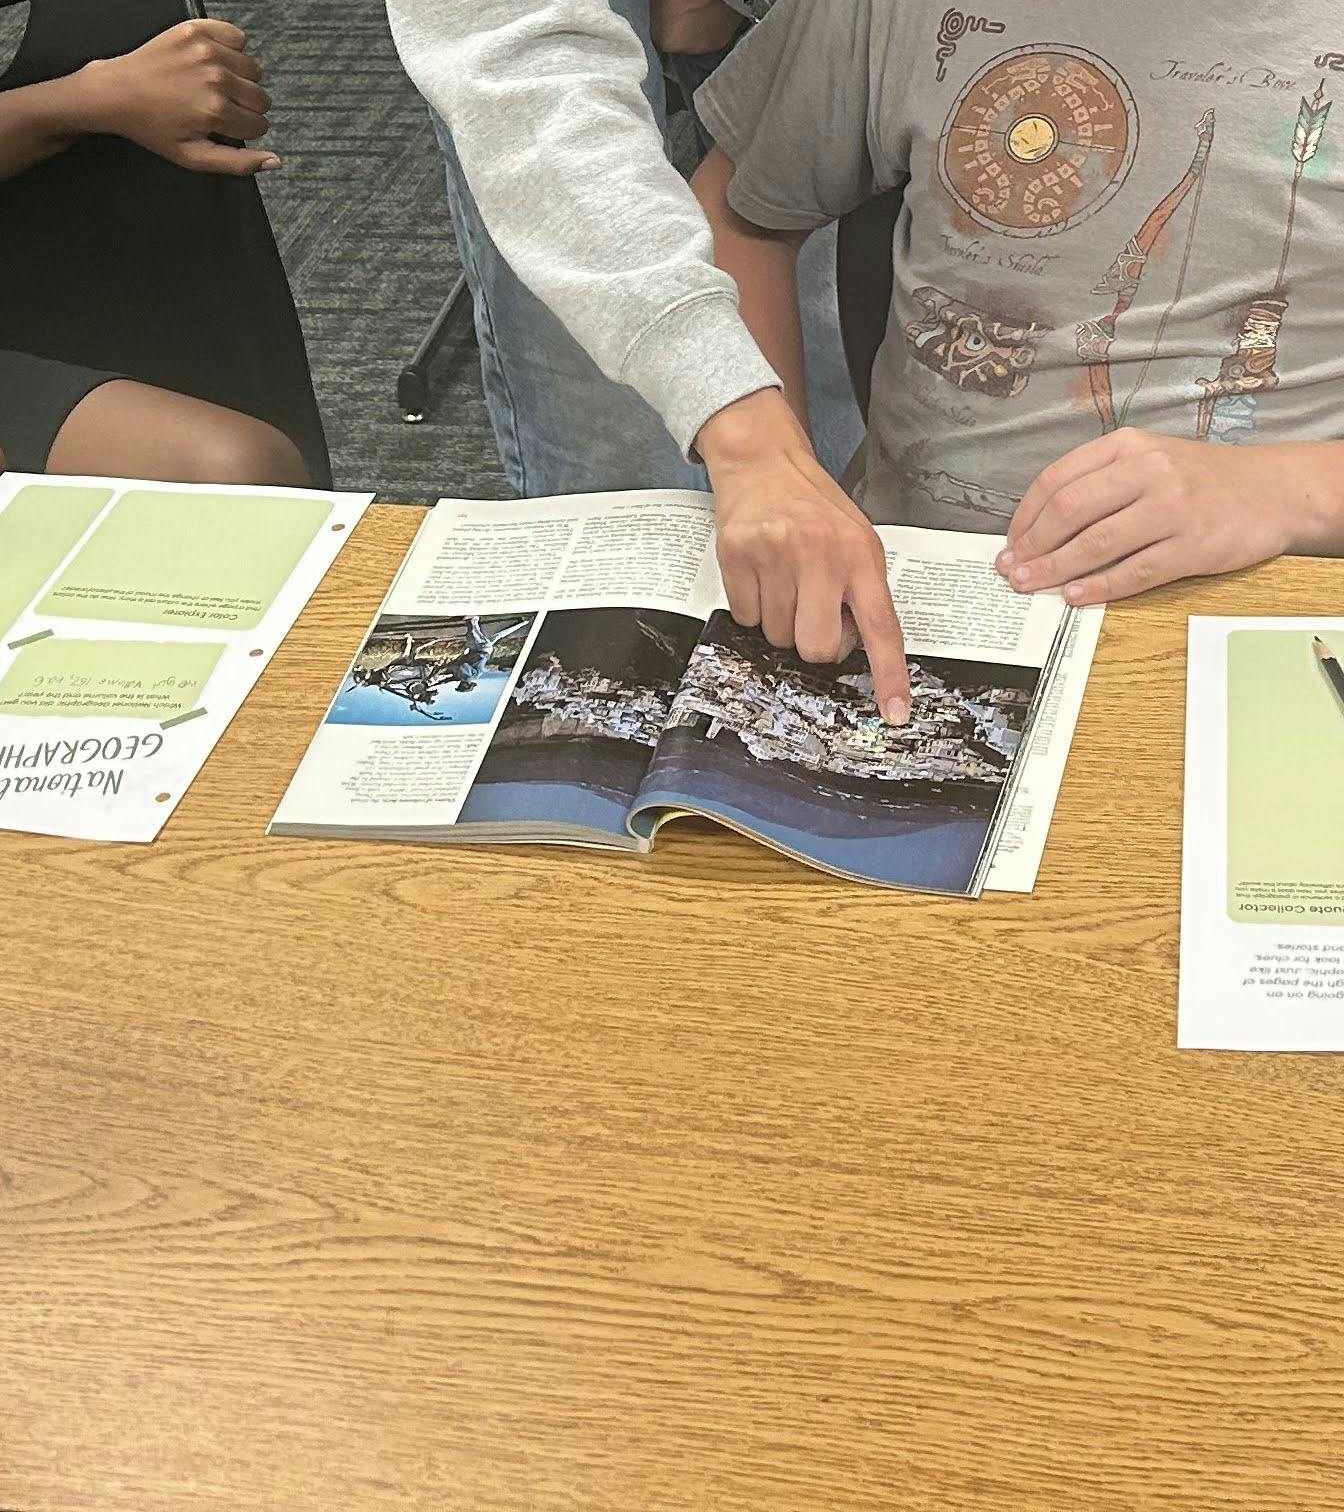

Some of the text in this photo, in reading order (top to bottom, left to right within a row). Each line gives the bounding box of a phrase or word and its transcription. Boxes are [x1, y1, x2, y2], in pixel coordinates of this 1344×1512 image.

[162, 610, 206, 618] Explorer
[1239, 904, 1305, 914] Collector
[1242, 978, 1255, 986] of
[1259, 978, 1299, 986] pages
[1308, 991, 1344, 999] going
